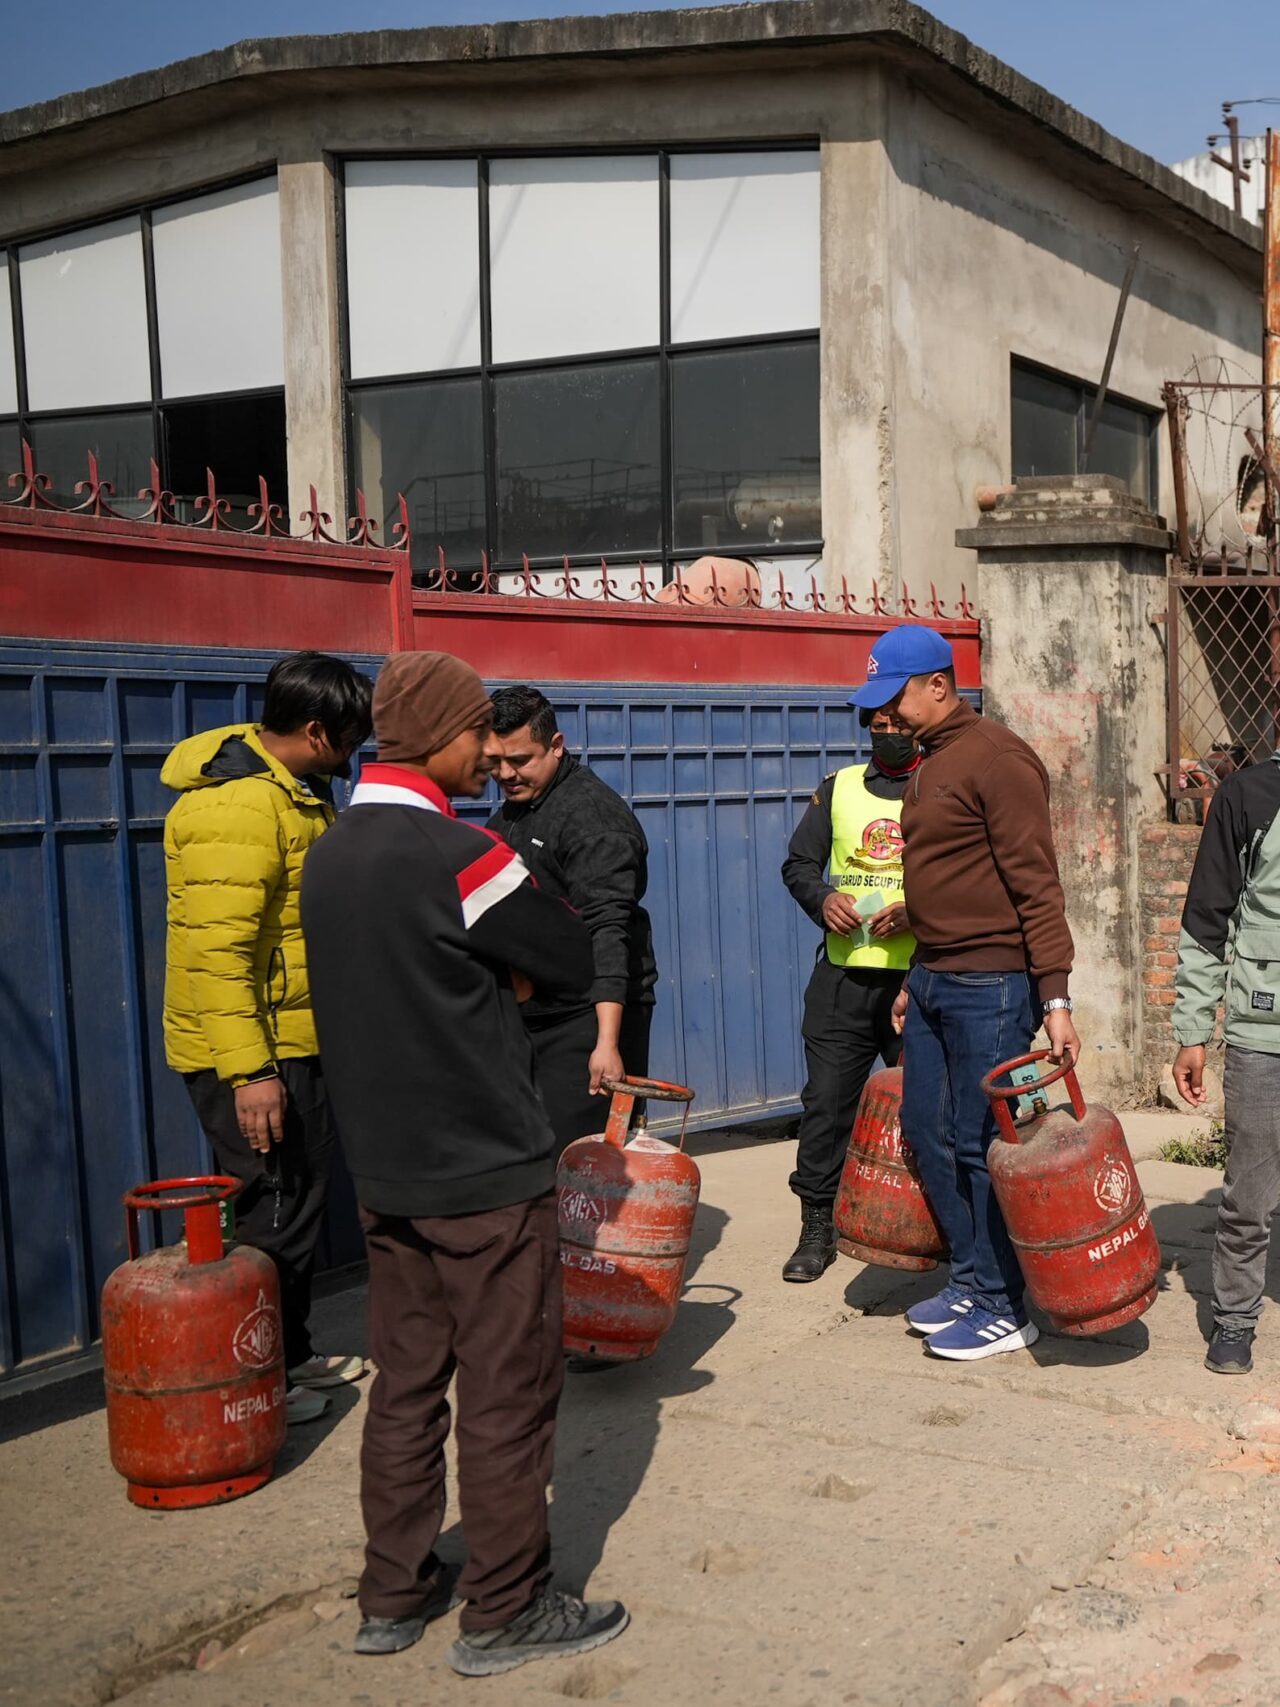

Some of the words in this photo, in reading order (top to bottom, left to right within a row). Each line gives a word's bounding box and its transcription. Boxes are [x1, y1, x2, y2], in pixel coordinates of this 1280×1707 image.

[1087, 1227, 1139, 1262] NEPAL
[579, 1256, 616, 1274] GAS
[224, 1392, 271, 1424] NEPAL
